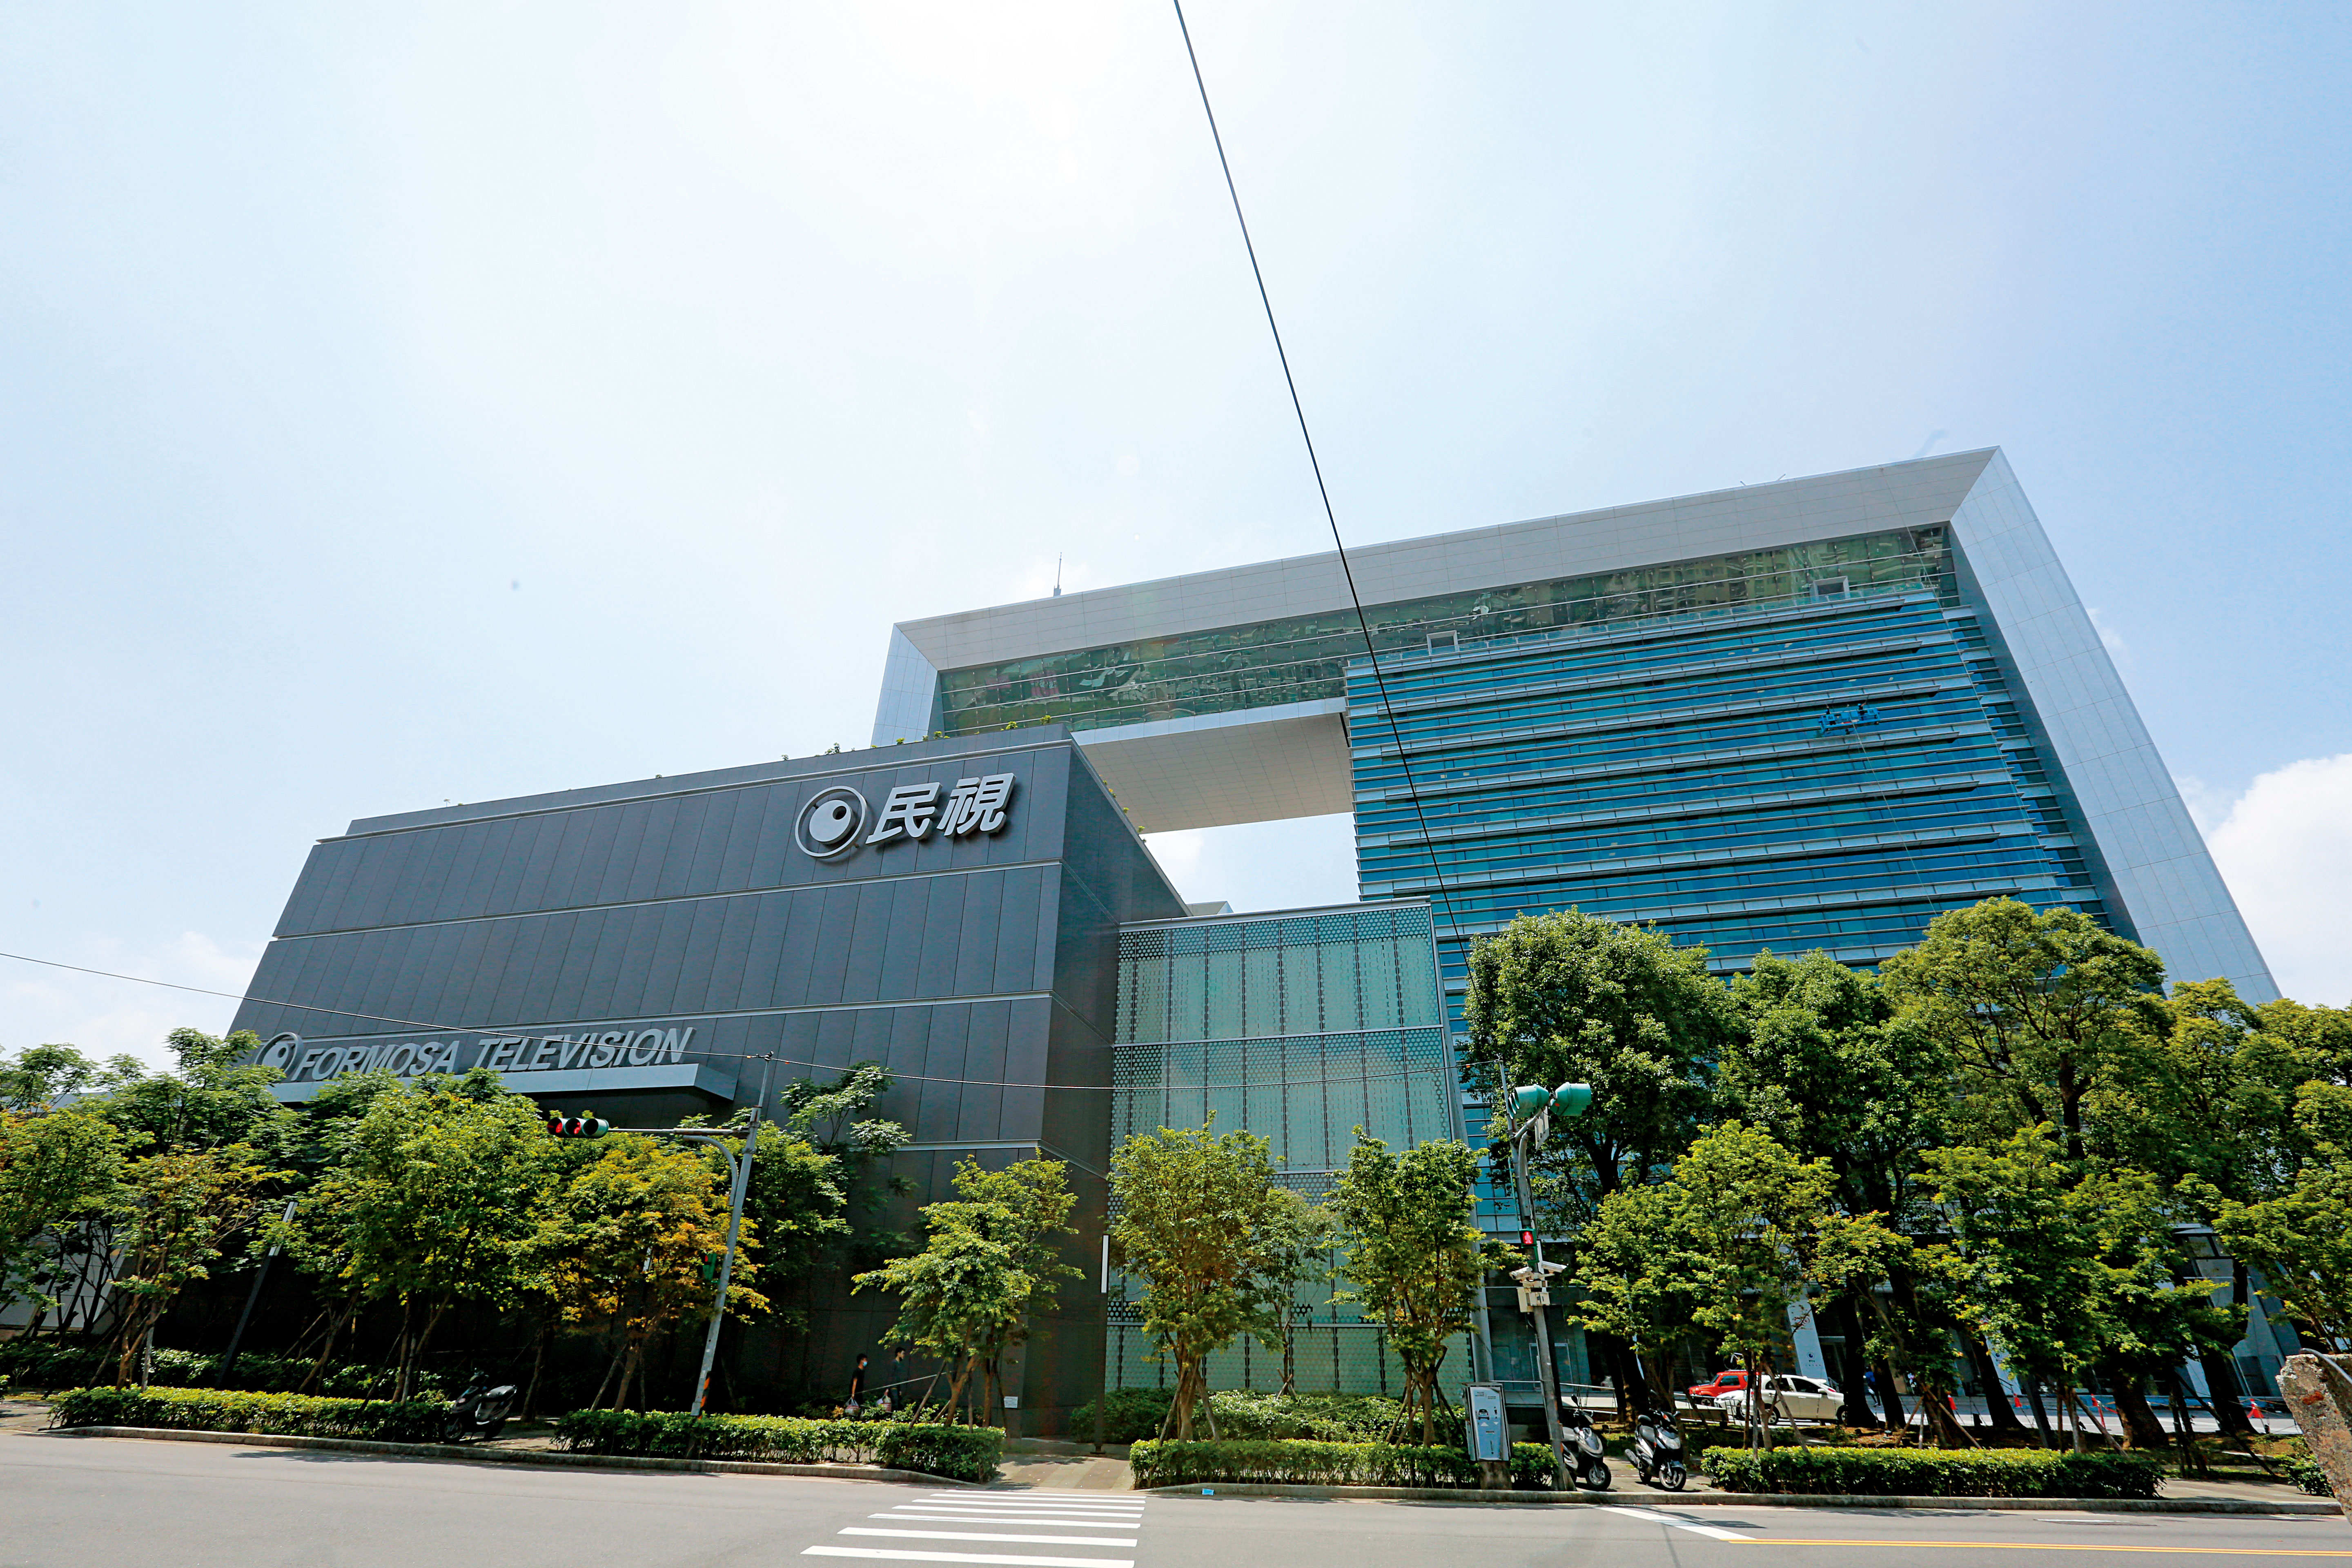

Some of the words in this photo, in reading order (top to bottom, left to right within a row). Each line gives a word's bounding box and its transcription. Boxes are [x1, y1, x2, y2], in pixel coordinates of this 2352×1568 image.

[865, 772, 1016, 845] 民視
[291, 1040, 460, 1081] FORMOSA
[474, 1027, 697, 1071] TELEVISION
